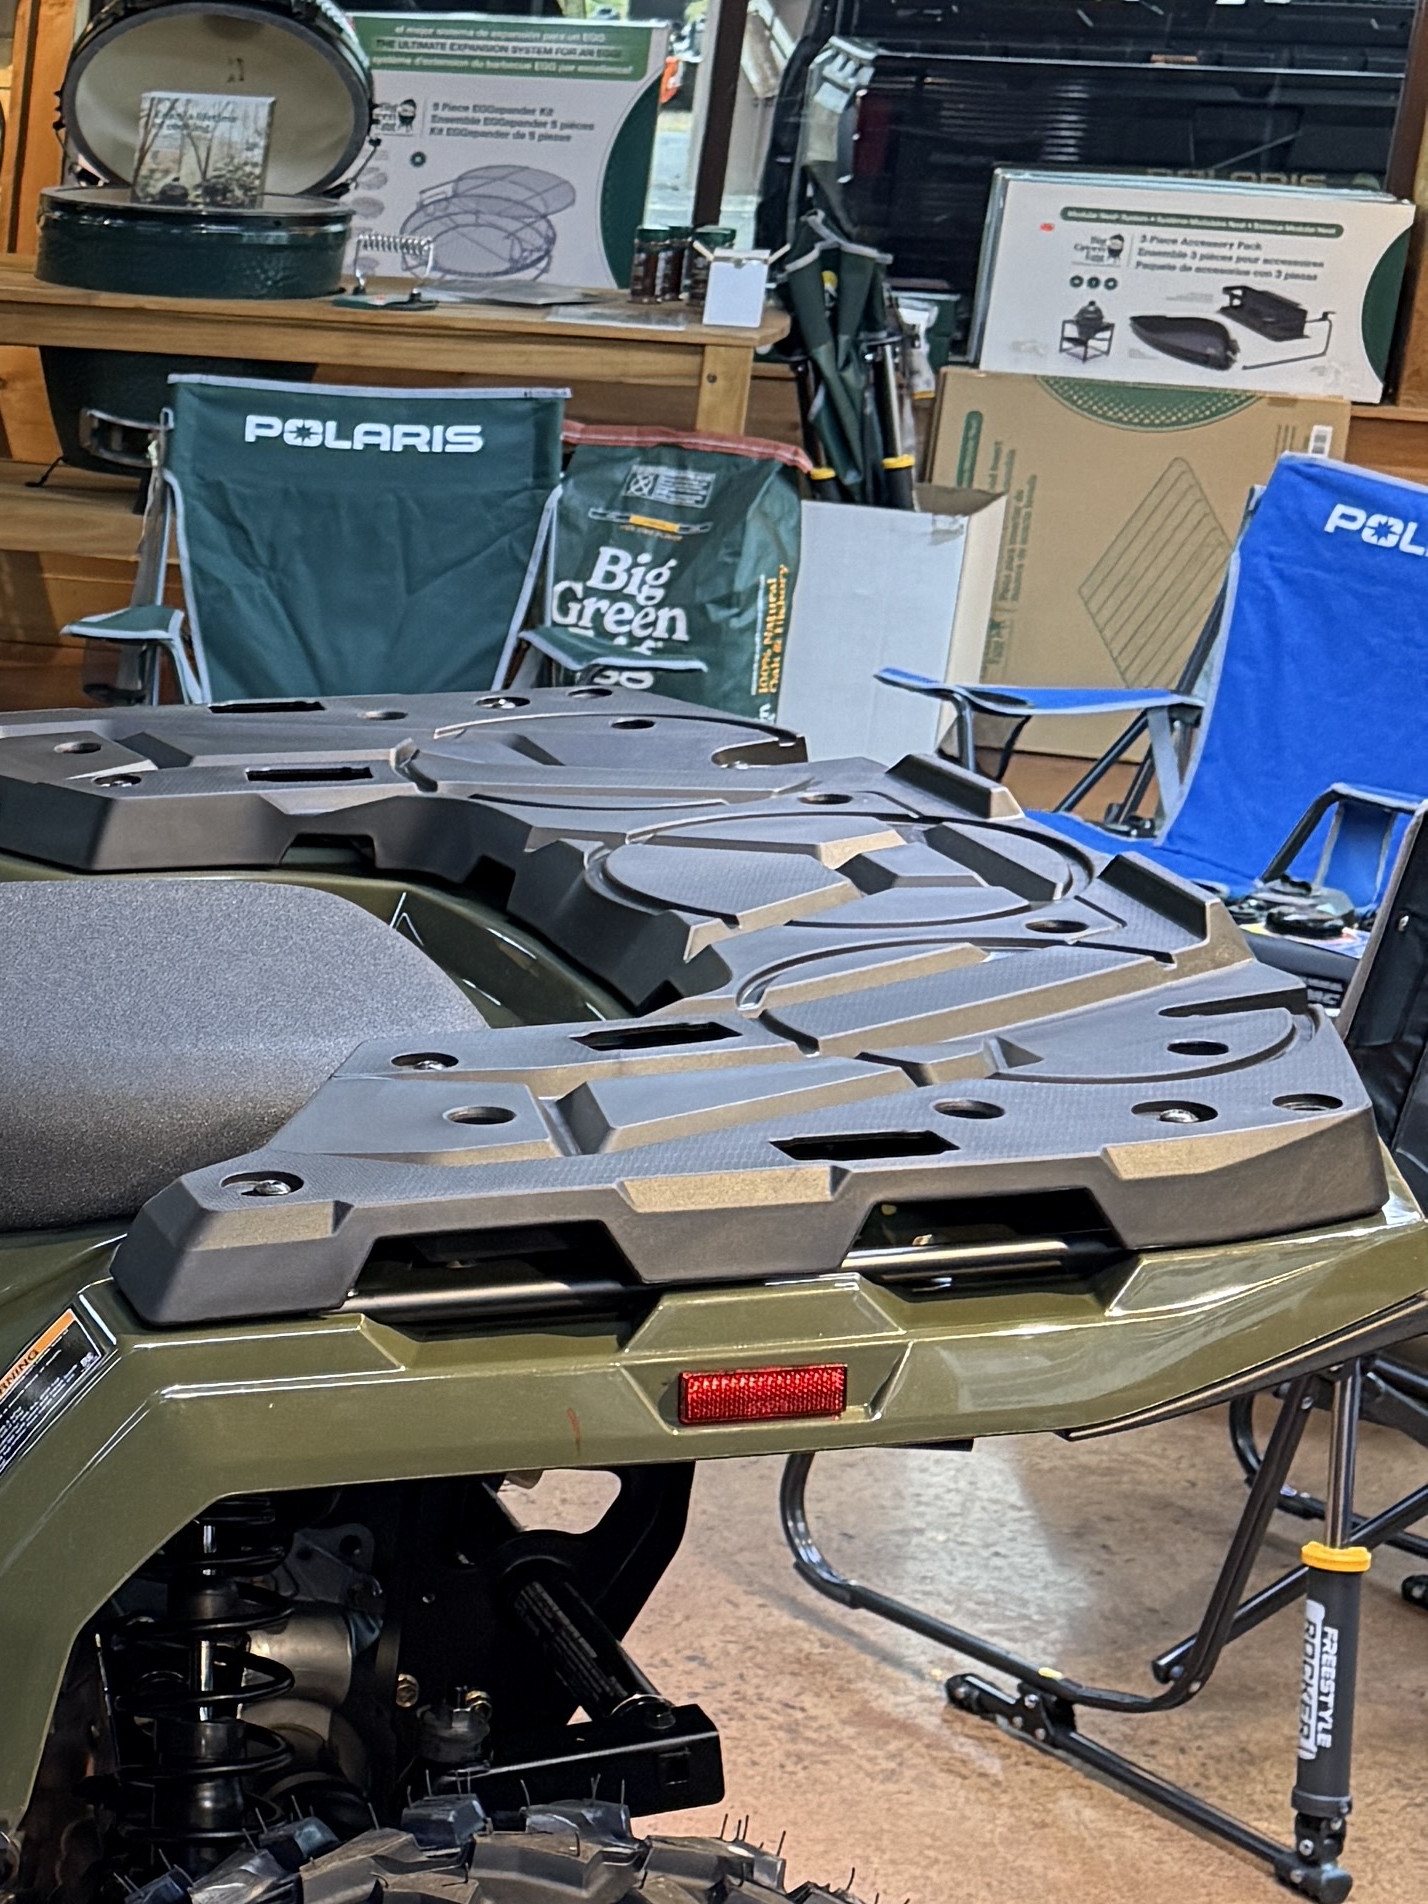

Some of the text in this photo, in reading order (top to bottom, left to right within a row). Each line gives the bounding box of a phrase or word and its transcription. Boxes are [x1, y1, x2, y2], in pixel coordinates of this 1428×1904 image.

[244, 414, 485, 453] POLARIS
[1324, 503, 1428, 557] POL
[586, 546, 678, 607] Big
[551, 580, 690, 642] Green
[1298, 1619, 1318, 1740] ROCKER
[1315, 1625, 1340, 1749] FREESTYLE
